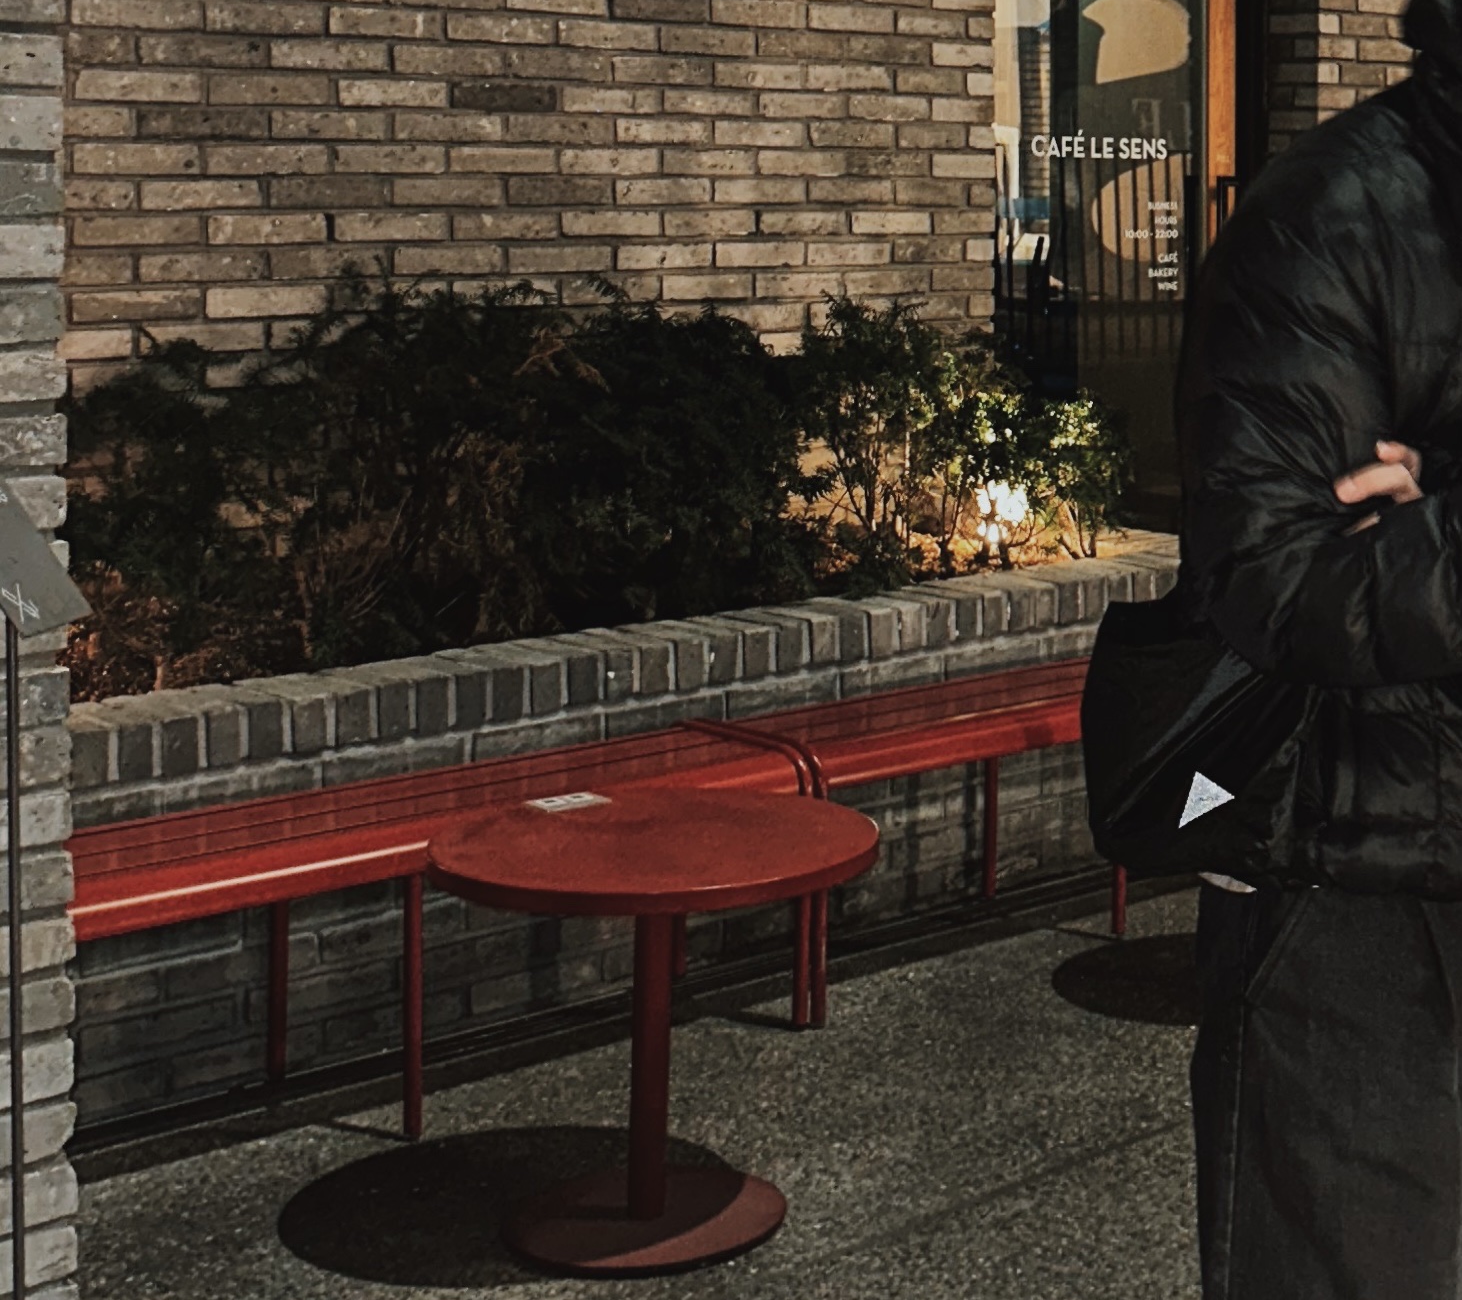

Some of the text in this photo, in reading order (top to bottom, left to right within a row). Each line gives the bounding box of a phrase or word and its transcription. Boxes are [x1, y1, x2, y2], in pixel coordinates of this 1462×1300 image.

[1031, 129, 1168, 160] CAFÉ LE SENS
[1154, 215, 1178, 225] HOURS
[1125, 229, 1149, 239] 10:00
[1155, 229, 1179, 239] 22:00
[1157, 251, 1178, 263] CAFÉ
[1148, 267, 1178, 278] BAKERY
[1157, 281, 1178, 291] WINE
